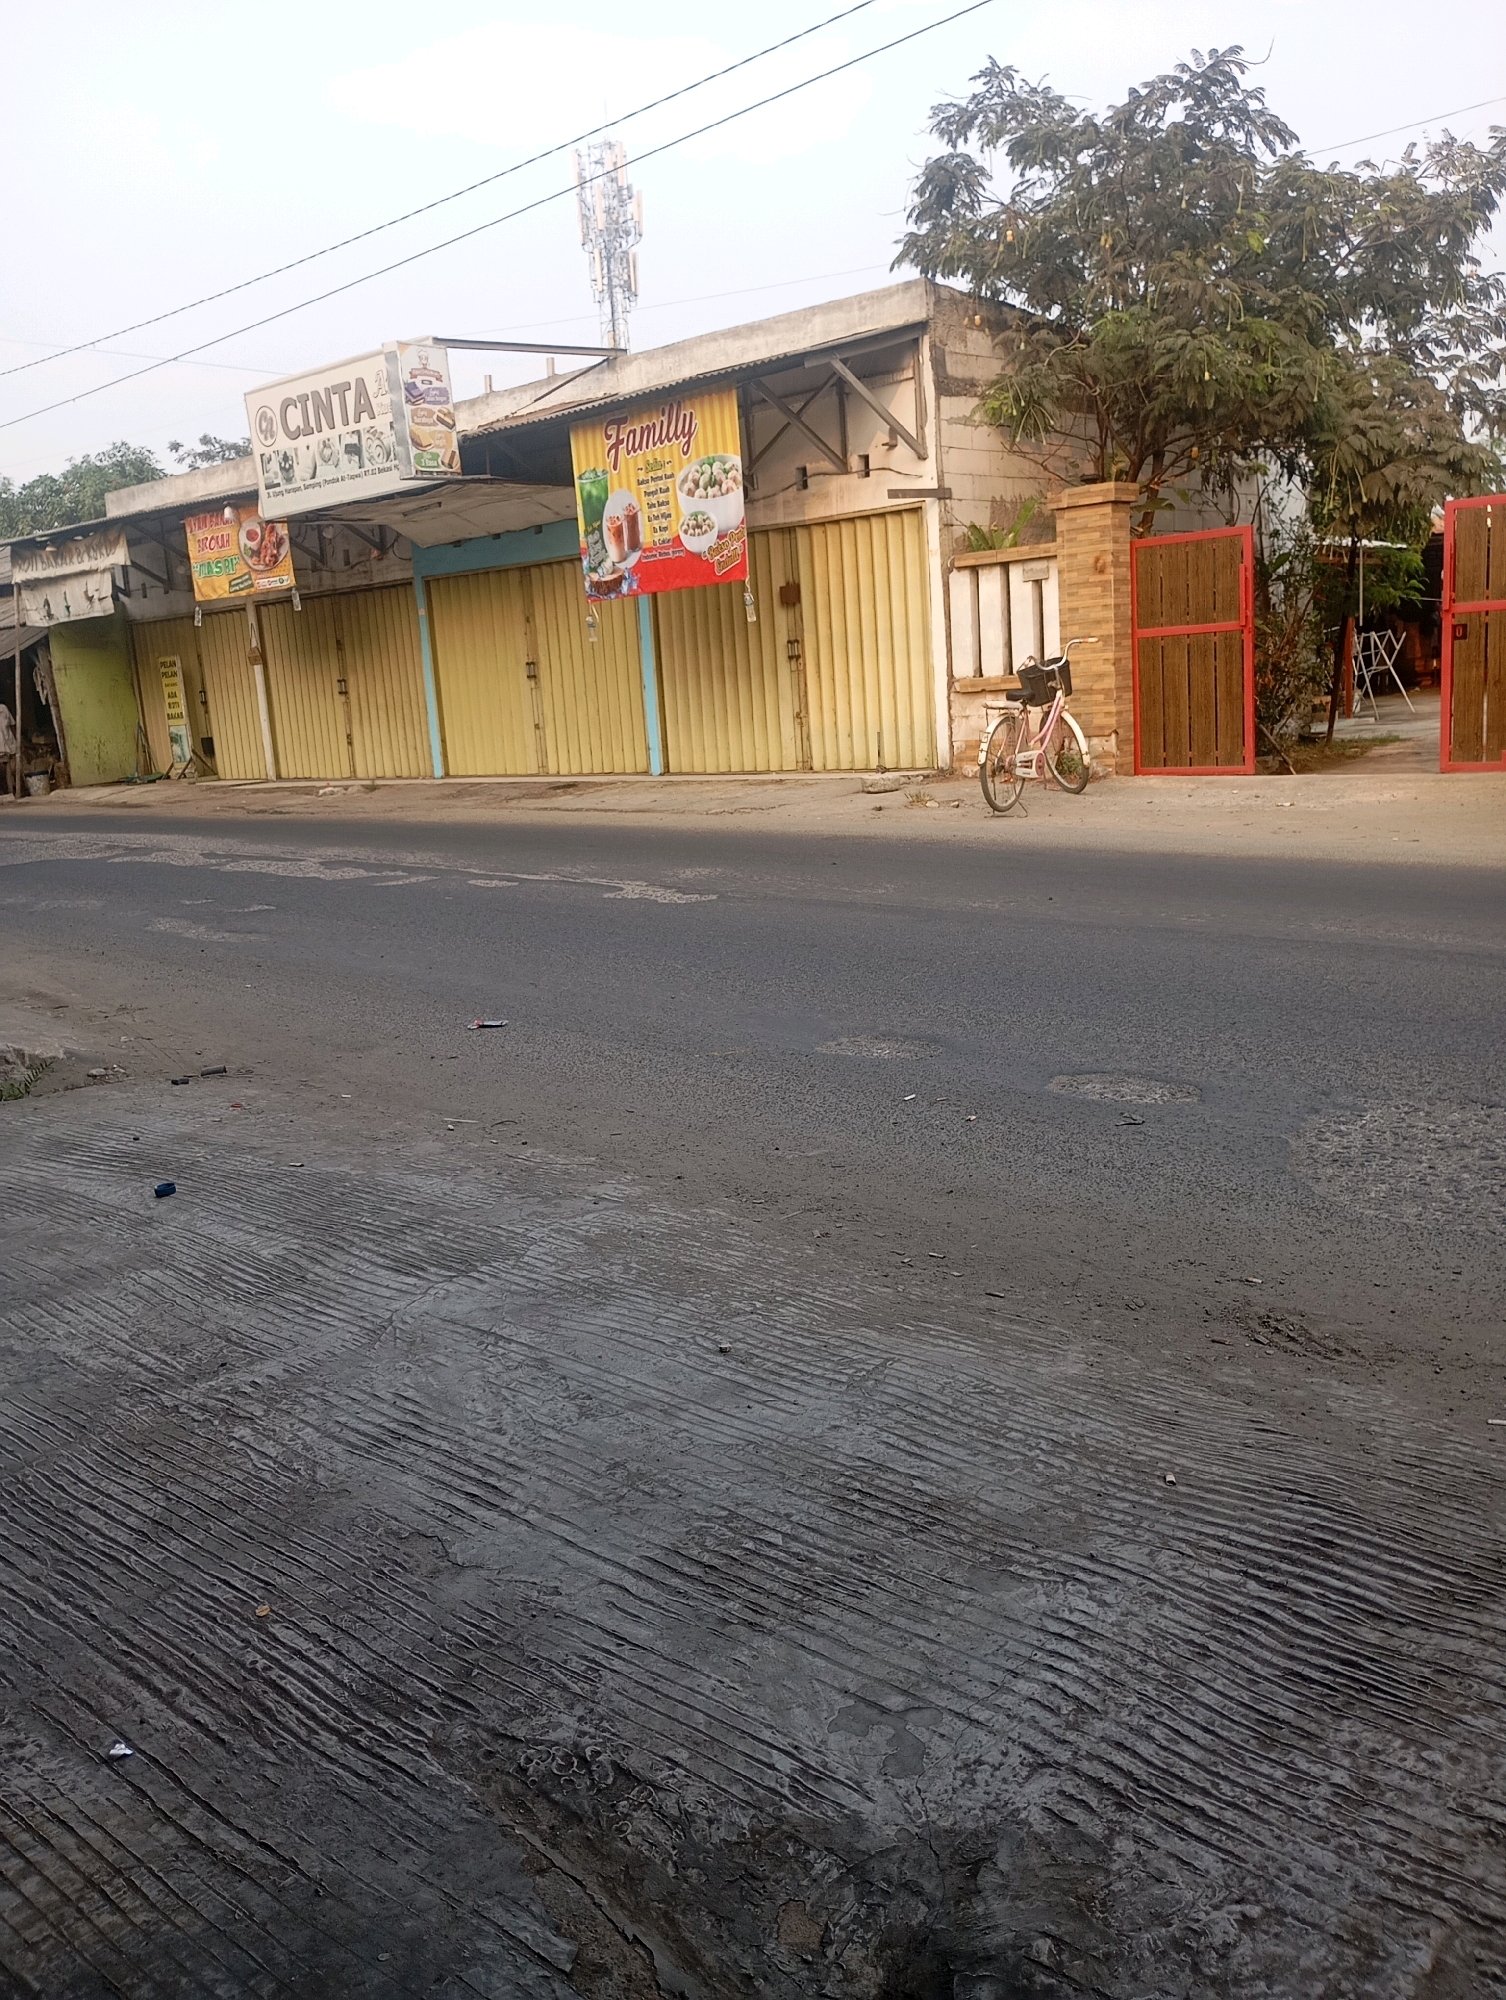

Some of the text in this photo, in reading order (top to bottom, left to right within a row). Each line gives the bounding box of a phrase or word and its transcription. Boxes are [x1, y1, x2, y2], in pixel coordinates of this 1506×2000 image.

[280, 369, 388, 440] CINTA A
[605, 402, 697, 470] Familly
[378, 464, 393, 474] Bekasi
[160, 660, 177, 669] PELAN
[161, 670, 178, 679] PELAN
[167, 691, 178, 699] ADA
